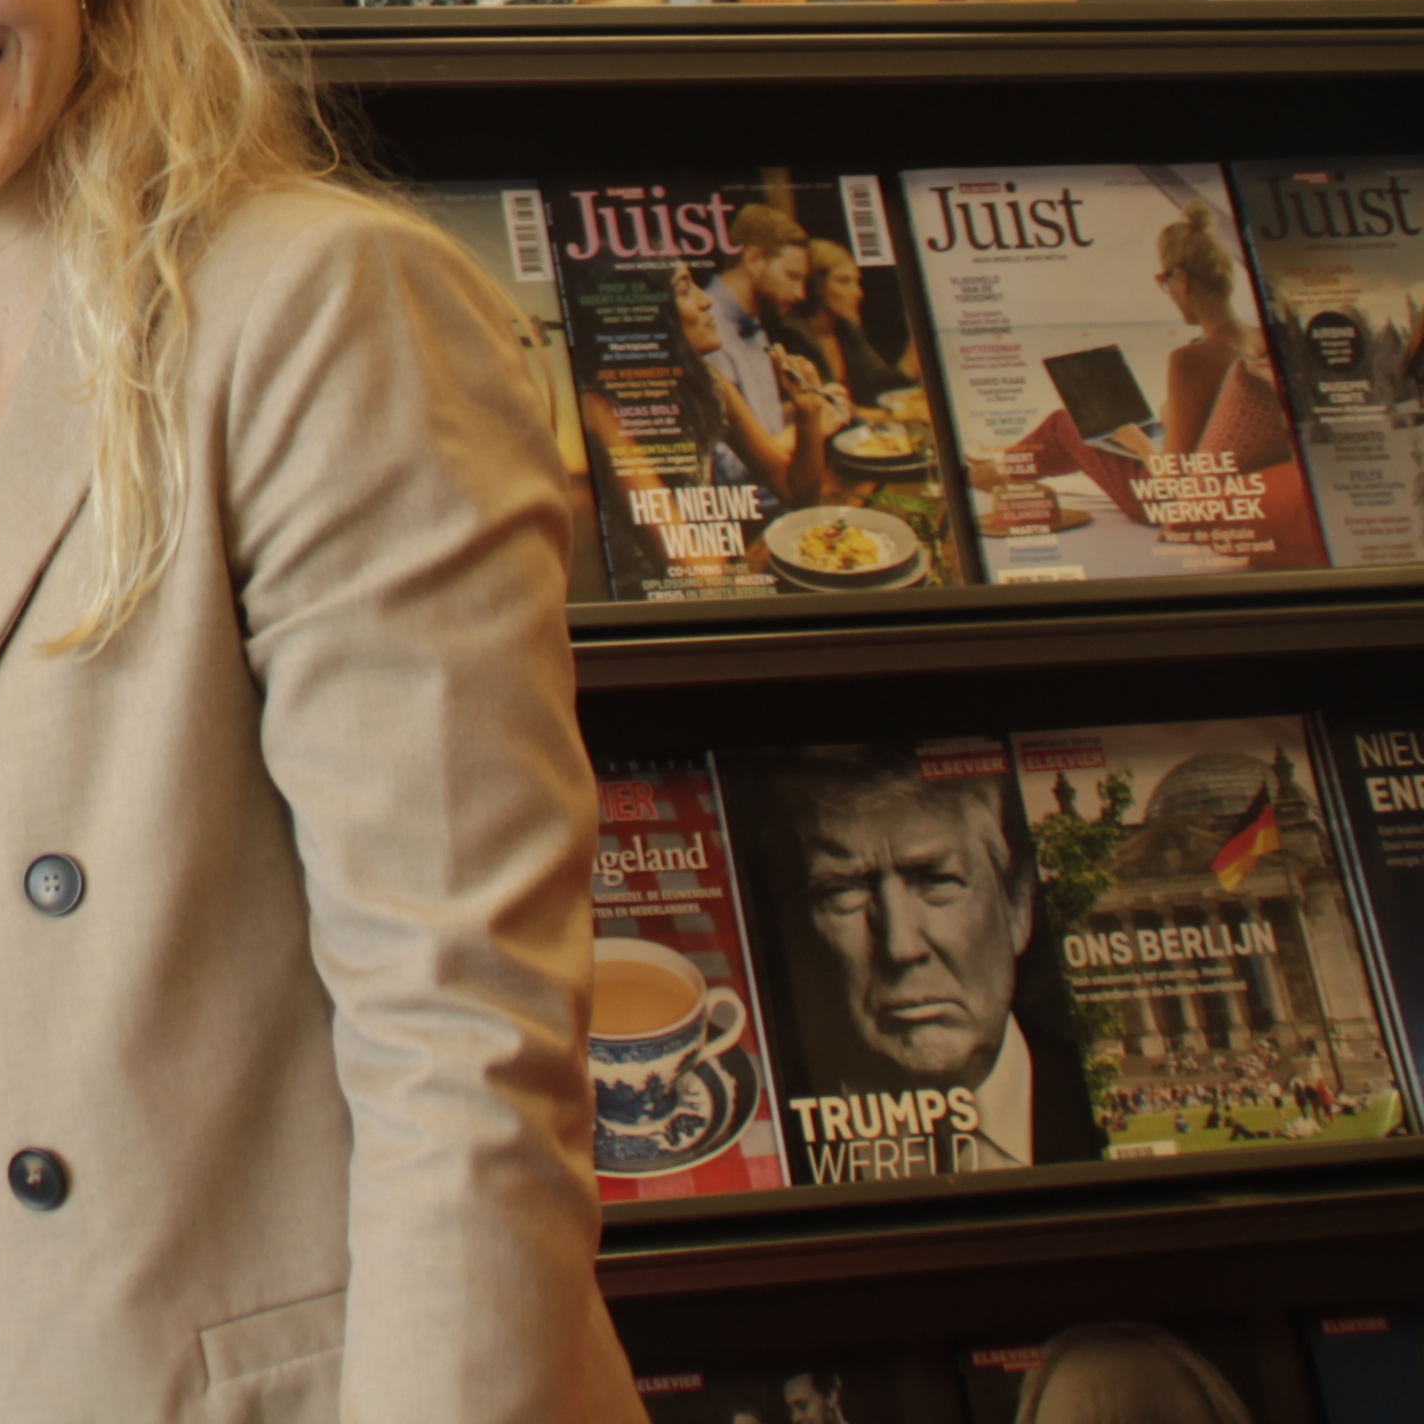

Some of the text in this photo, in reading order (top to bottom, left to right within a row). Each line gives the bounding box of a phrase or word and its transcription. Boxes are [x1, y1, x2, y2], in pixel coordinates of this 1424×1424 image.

[566, 186, 743, 260] Juist
[927, 181, 1094, 252] Juist
[1260, 171, 1423, 241] Juist
[1150, 451, 1238, 475] DE HELE
[629, 485, 764, 525] HET NIEUWE
[1130, 474, 1265, 500] WERELD ALS
[1144, 498, 1265, 524] WERKPLEK
[660, 522, 744, 558] WONEN
[1063, 922, 1277, 967] ONS BERLIJN
[790, 1089, 979, 1144] TRUMPS
[807, 1132, 978, 1185] WERELD
